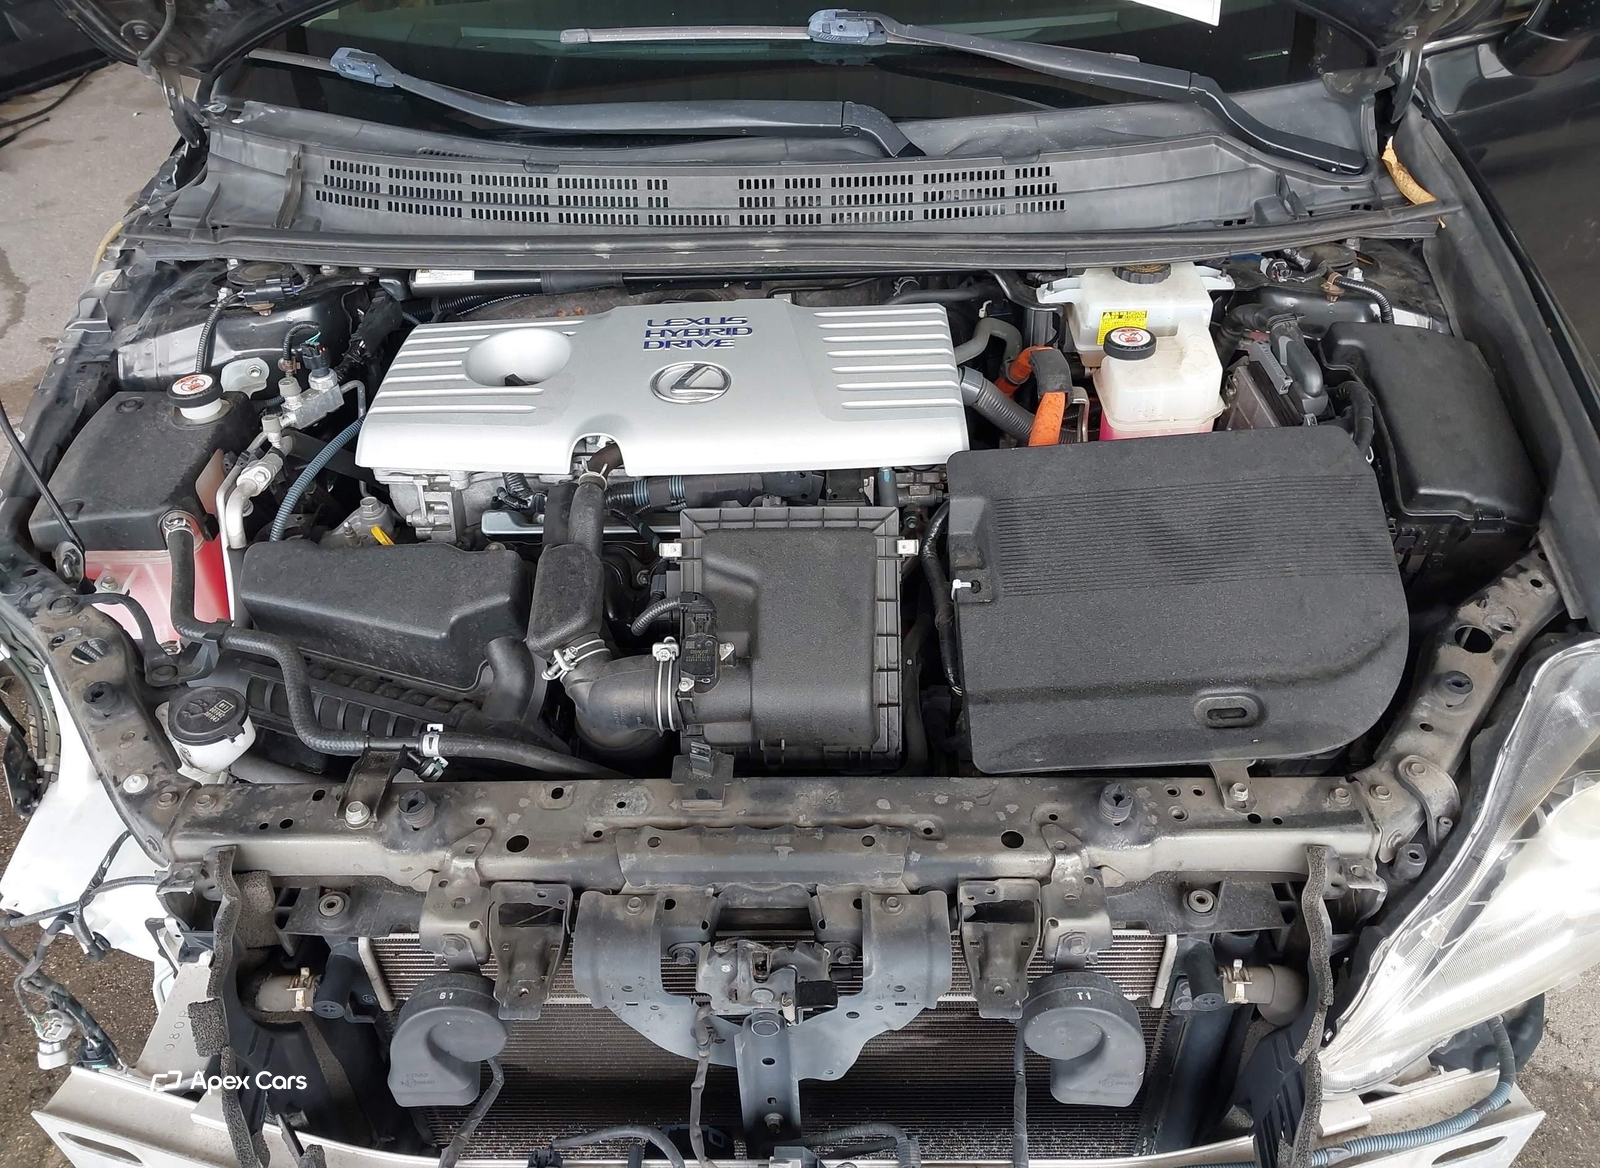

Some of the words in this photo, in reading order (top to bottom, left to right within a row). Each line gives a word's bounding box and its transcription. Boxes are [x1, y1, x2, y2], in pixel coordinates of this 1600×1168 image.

[647, 316, 748, 328] LEXUS
[645, 327, 753, 340] HYBRID
[643, 338, 736, 351] DRIVE
[1077, 992, 1092, 1000] T1
